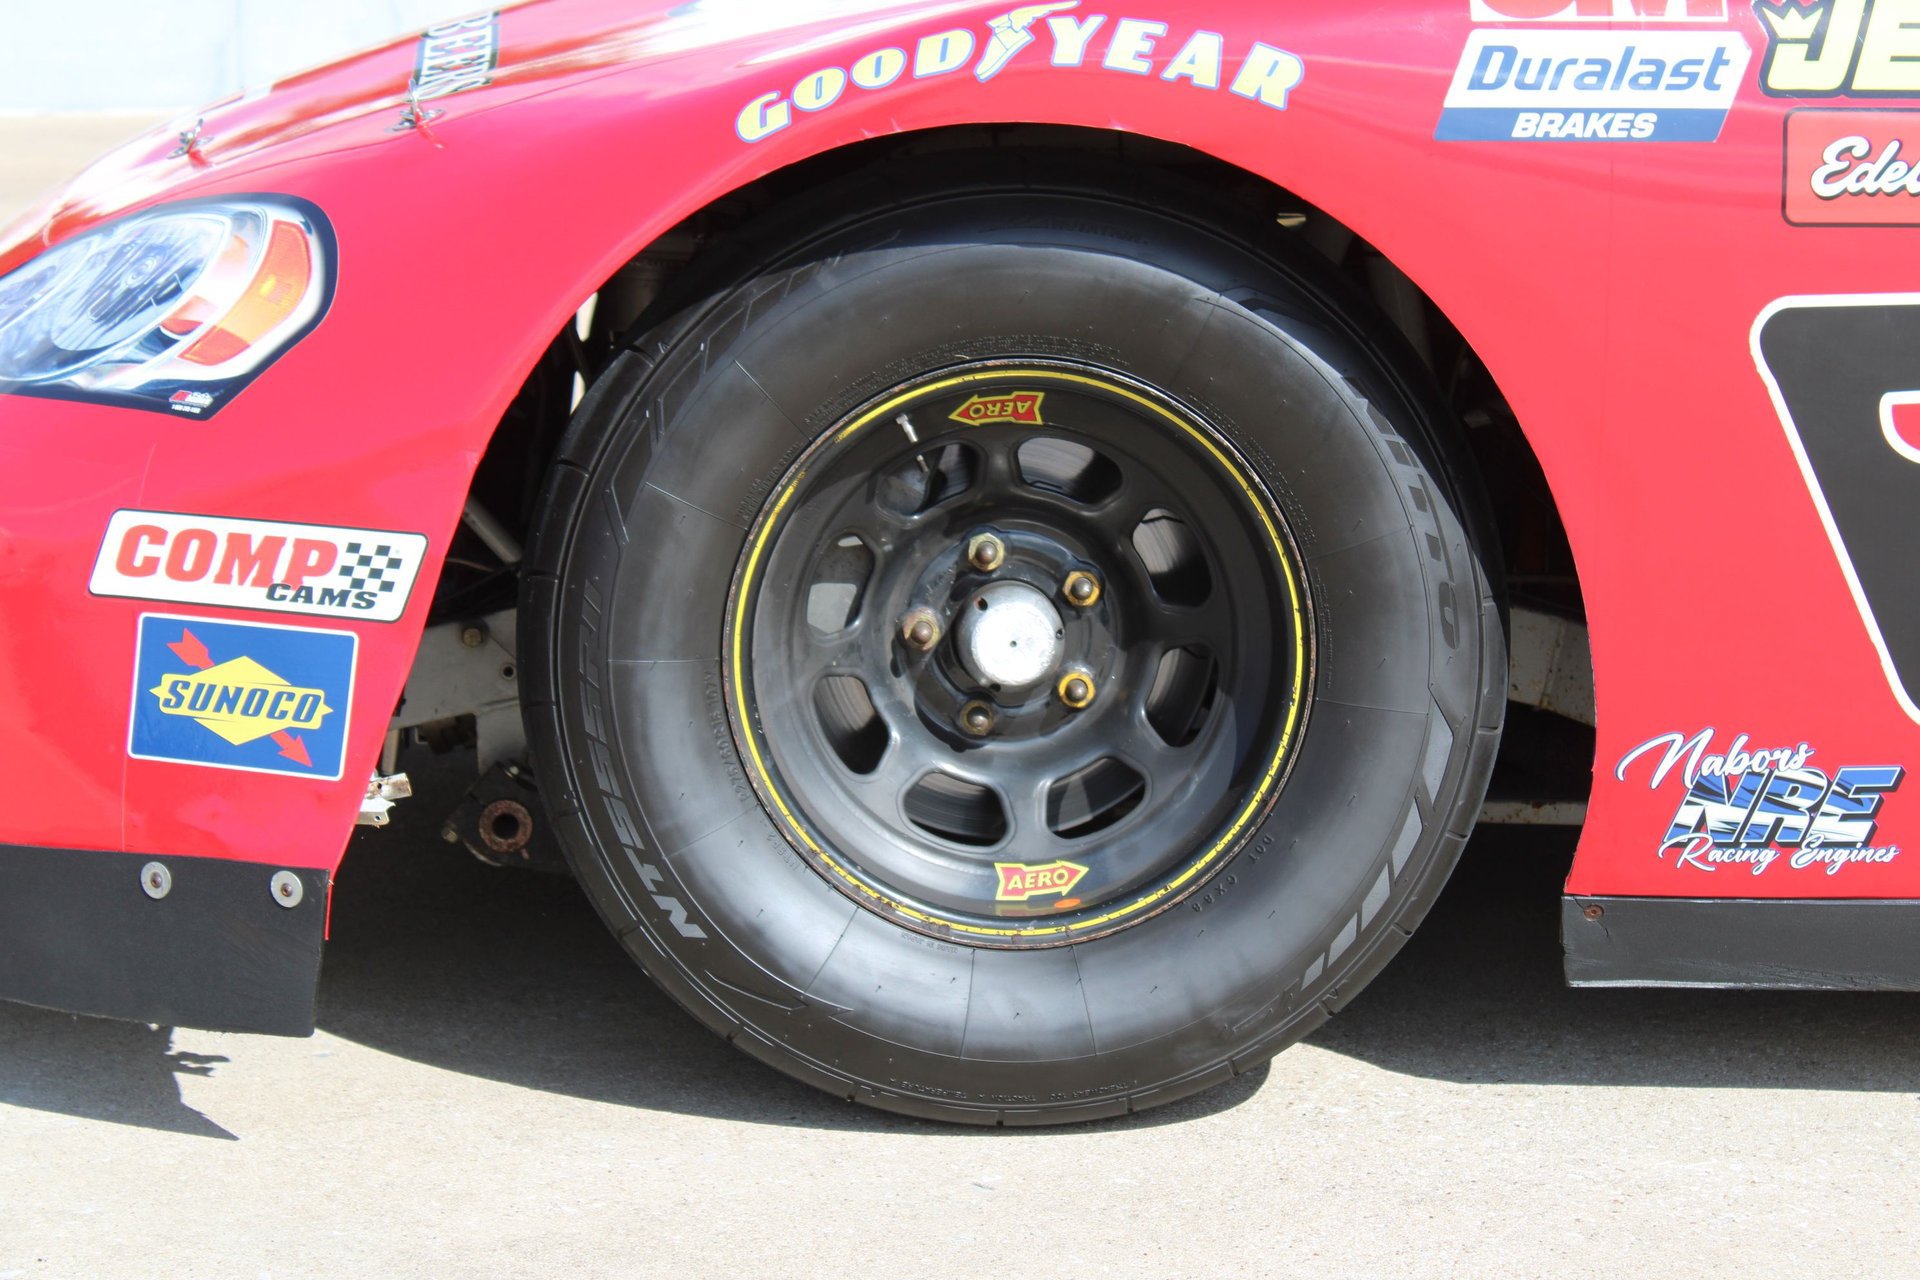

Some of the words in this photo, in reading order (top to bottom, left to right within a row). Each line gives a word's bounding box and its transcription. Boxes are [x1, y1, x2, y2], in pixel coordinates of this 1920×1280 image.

[1466, 45, 1730, 91] Duralast
[1511, 112, 1658, 139] BRAKES
[970, 399, 1029, 419] AERO
[115, 524, 339, 589] COMP
[265, 582, 378, 610] CAMS
[162, 680, 323, 723] SUNOCO
[1616, 728, 1814, 790] Nabors
[1663, 765, 1906, 847] NRE
[1247, 834, 1274, 865] DOT
[1658, 832, 1780, 876] Racing
[1790, 834, 1900, 876] Engines
[1007, 868, 1069, 890] AERO
